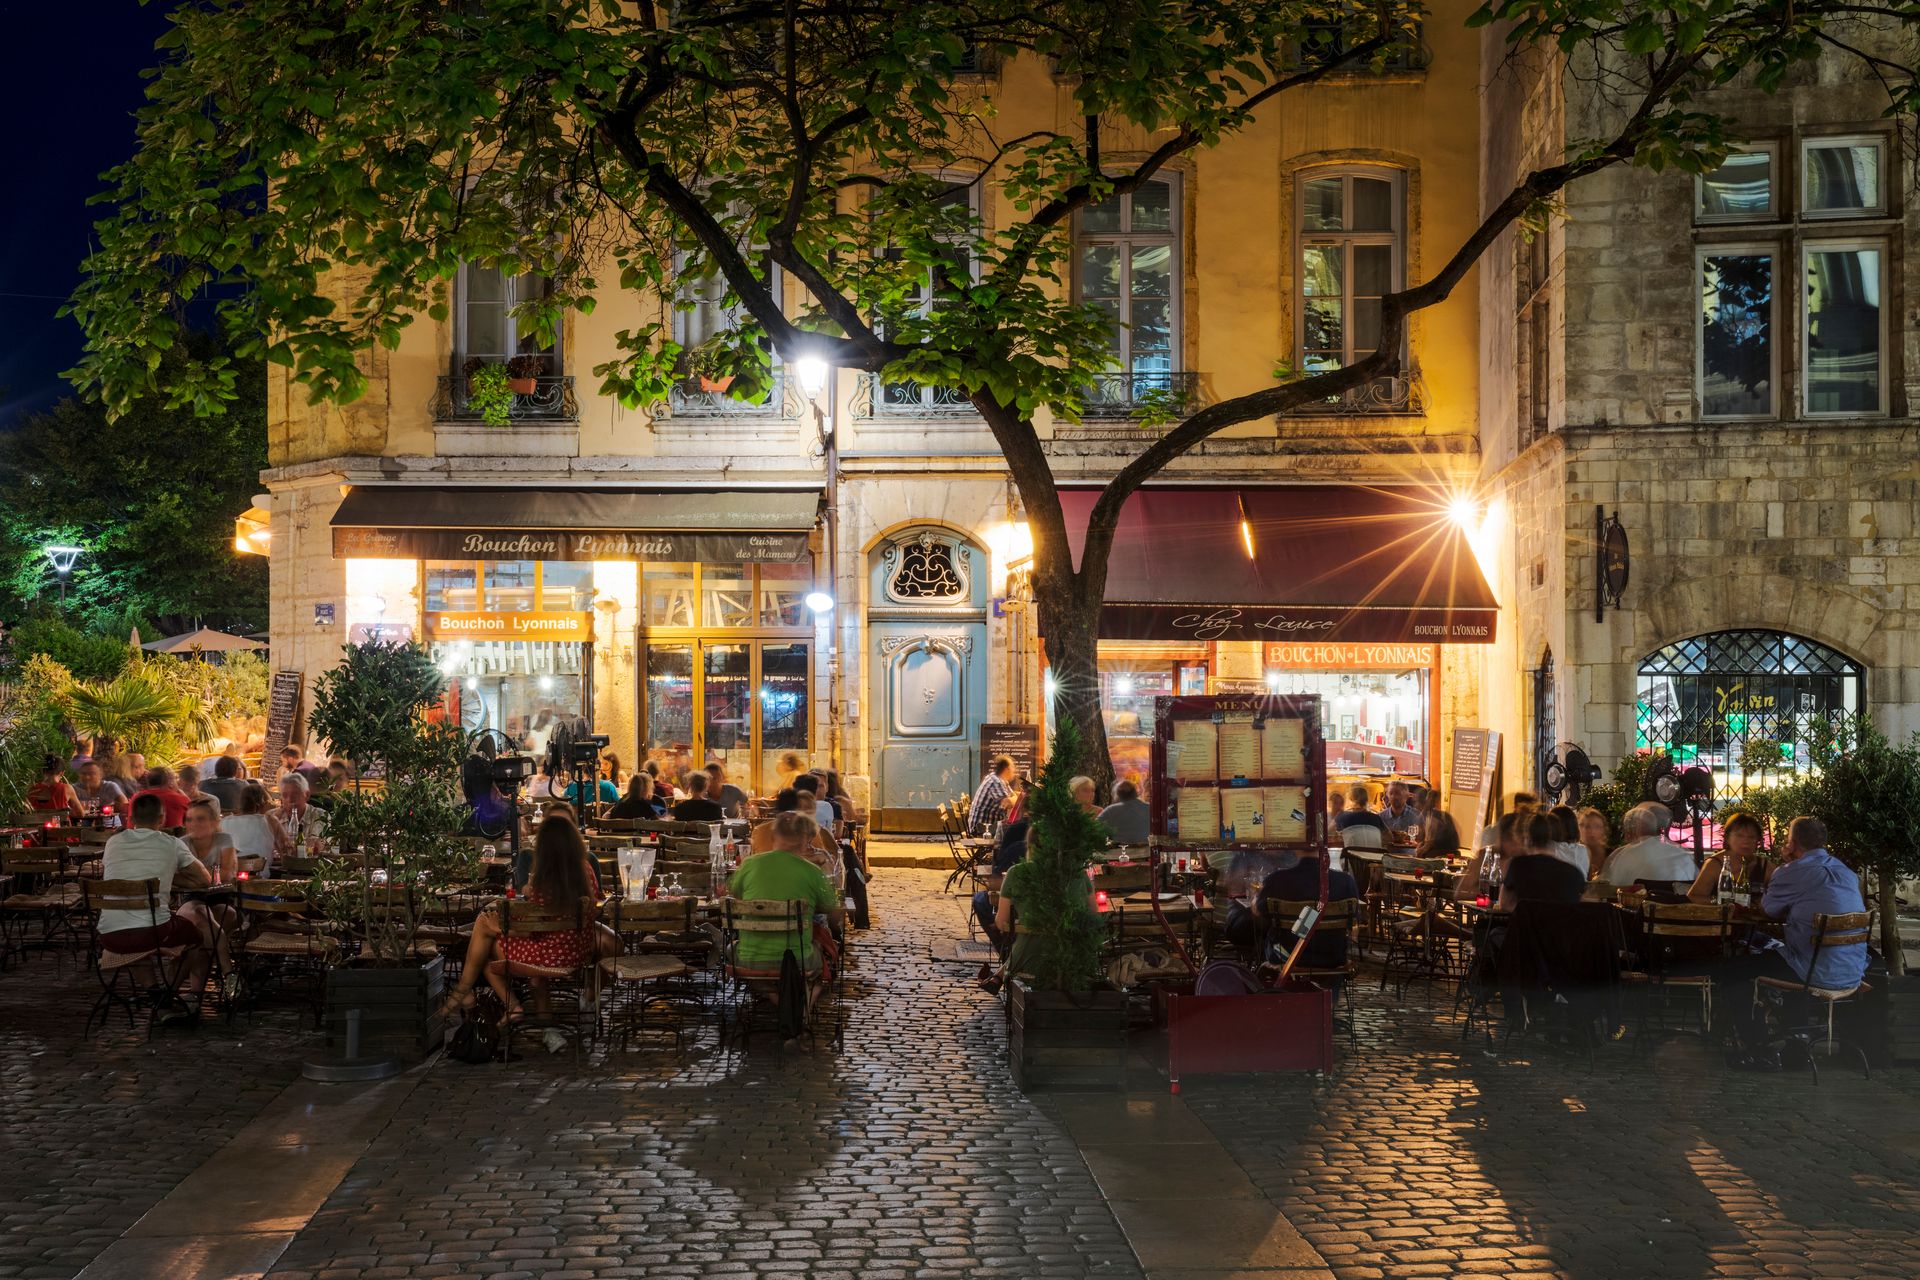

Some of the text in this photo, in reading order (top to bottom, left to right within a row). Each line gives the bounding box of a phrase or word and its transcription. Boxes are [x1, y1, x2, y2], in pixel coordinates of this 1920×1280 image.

[462, 534, 673, 559] Bouchon Lyonnais
[749, 536, 784, 546] Cuisine
[735, 549, 797, 559] des Mamans
[440, 616, 578, 632] Bouchon Lyonnais
[1172, 609, 1337, 640] Chez Louise
[1414, 625, 1488, 636] BOUCHON LYONNAIS
[1270, 646, 1432, 664] BOUCHON LYONNAIS
[1215, 700, 1264, 710] MENU
